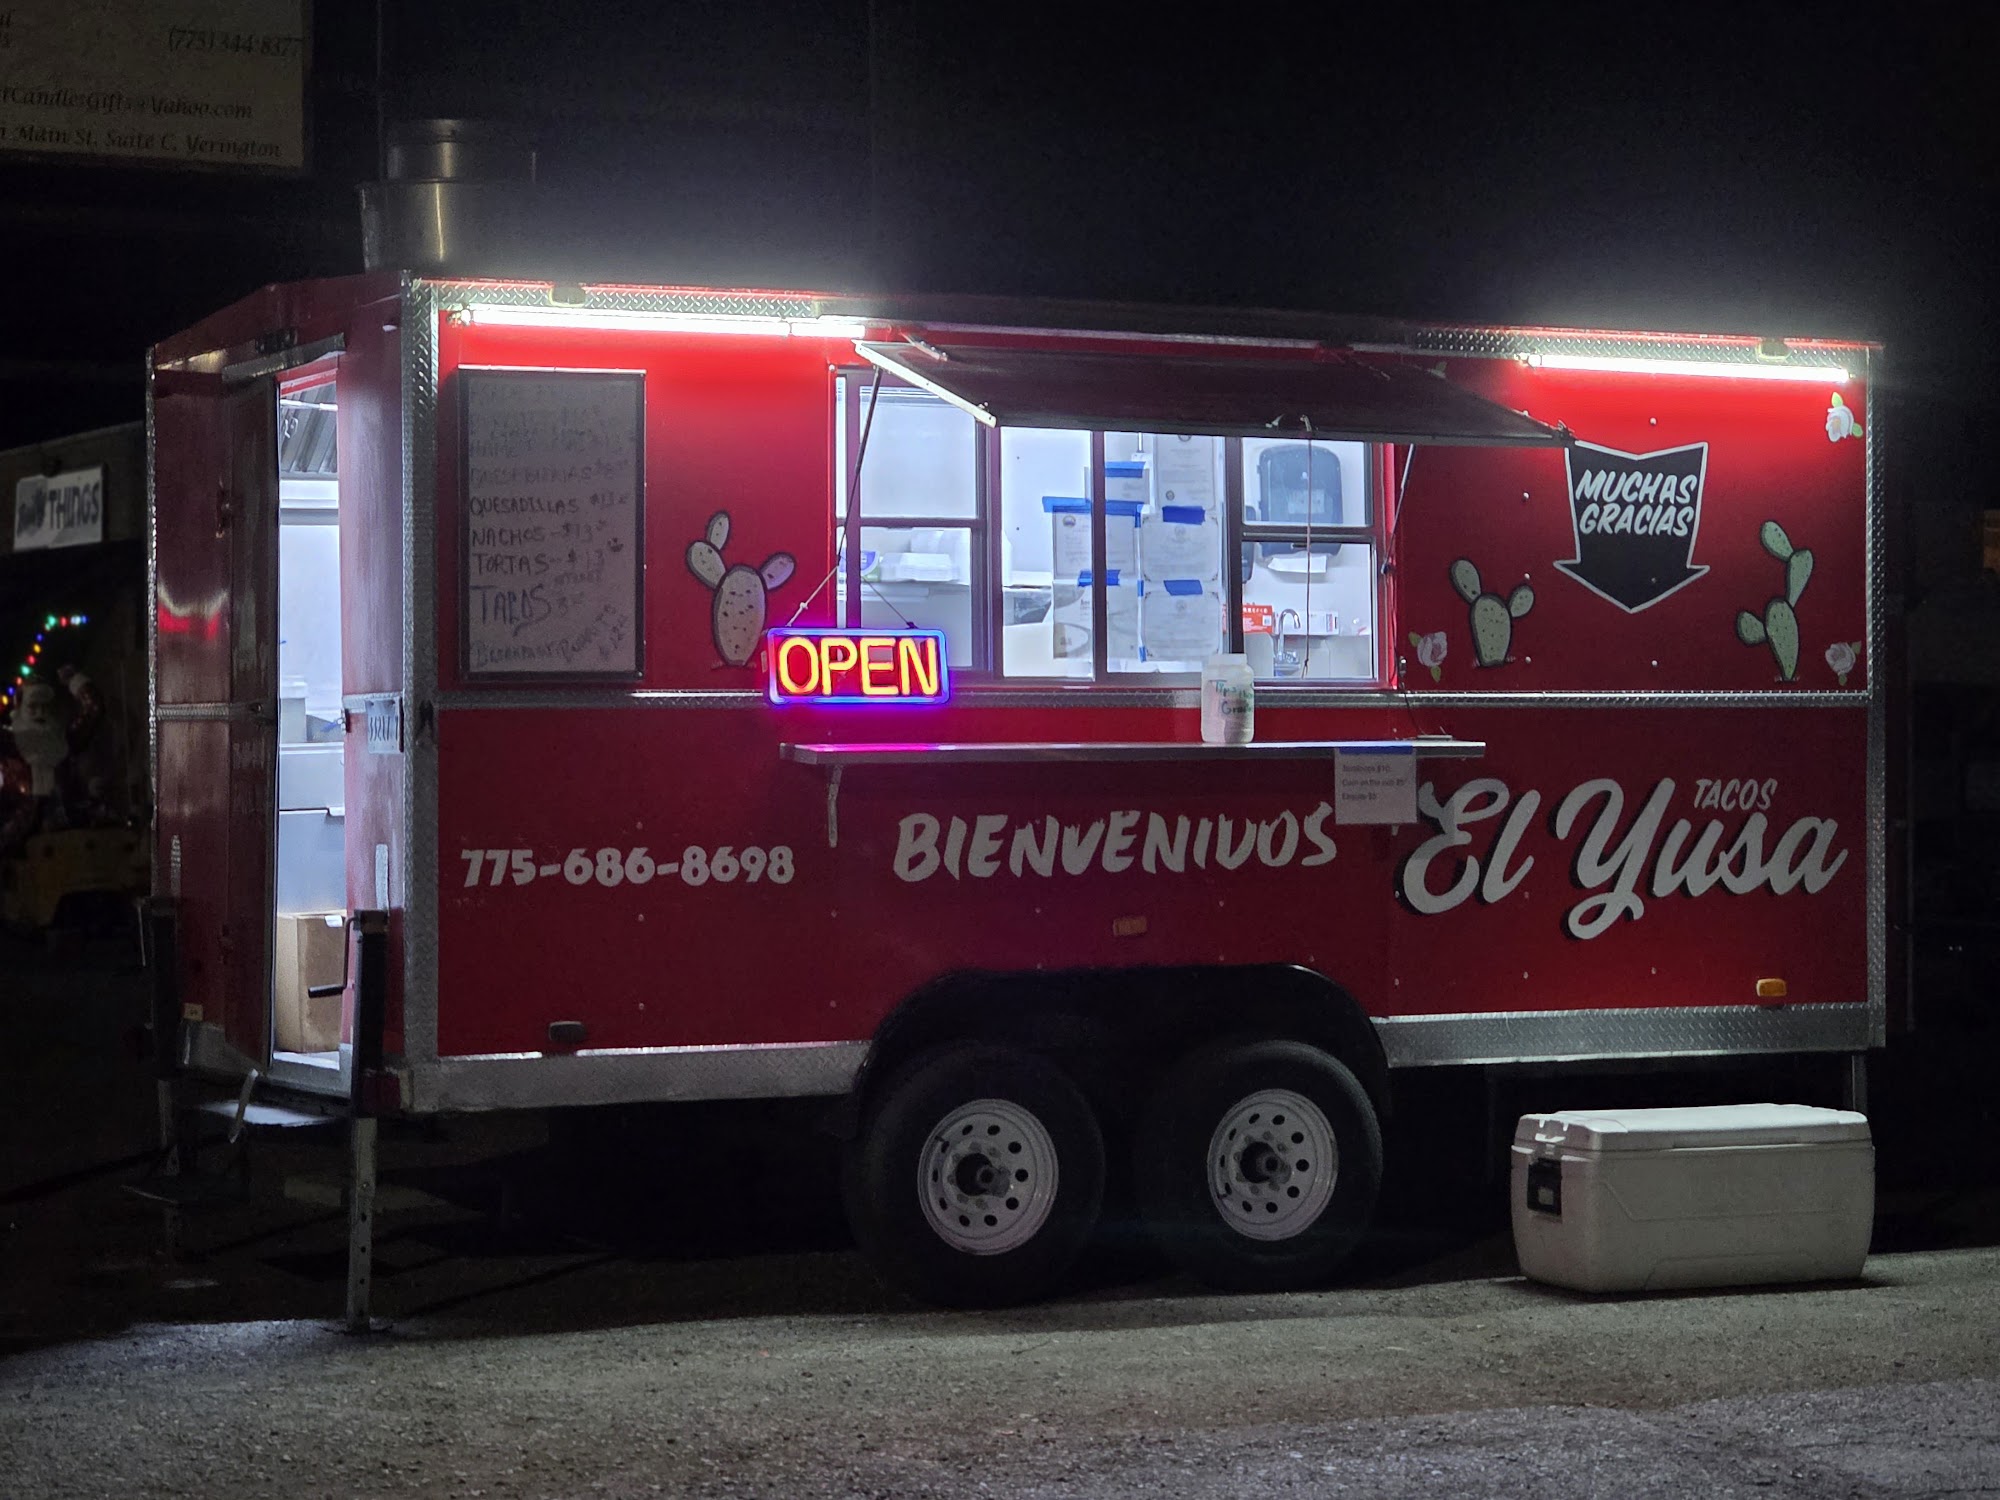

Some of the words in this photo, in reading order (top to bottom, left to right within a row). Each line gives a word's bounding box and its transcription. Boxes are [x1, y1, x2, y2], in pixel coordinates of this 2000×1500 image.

[1575, 469, 1698, 504] MUCHAS
[1579, 502, 1695, 537] GRACIAS
[472, 553, 551, 579] TORTAS
[779, 636, 939, 696] OPEN
[1694, 778, 1778, 811] TACOS
[892, 801, 1337, 883] BIENVENIDOS
[1402, 777, 1541, 914] El
[1555, 777, 1848, 941] Yusa
[461, 845, 795, 888] 775-686-8698
